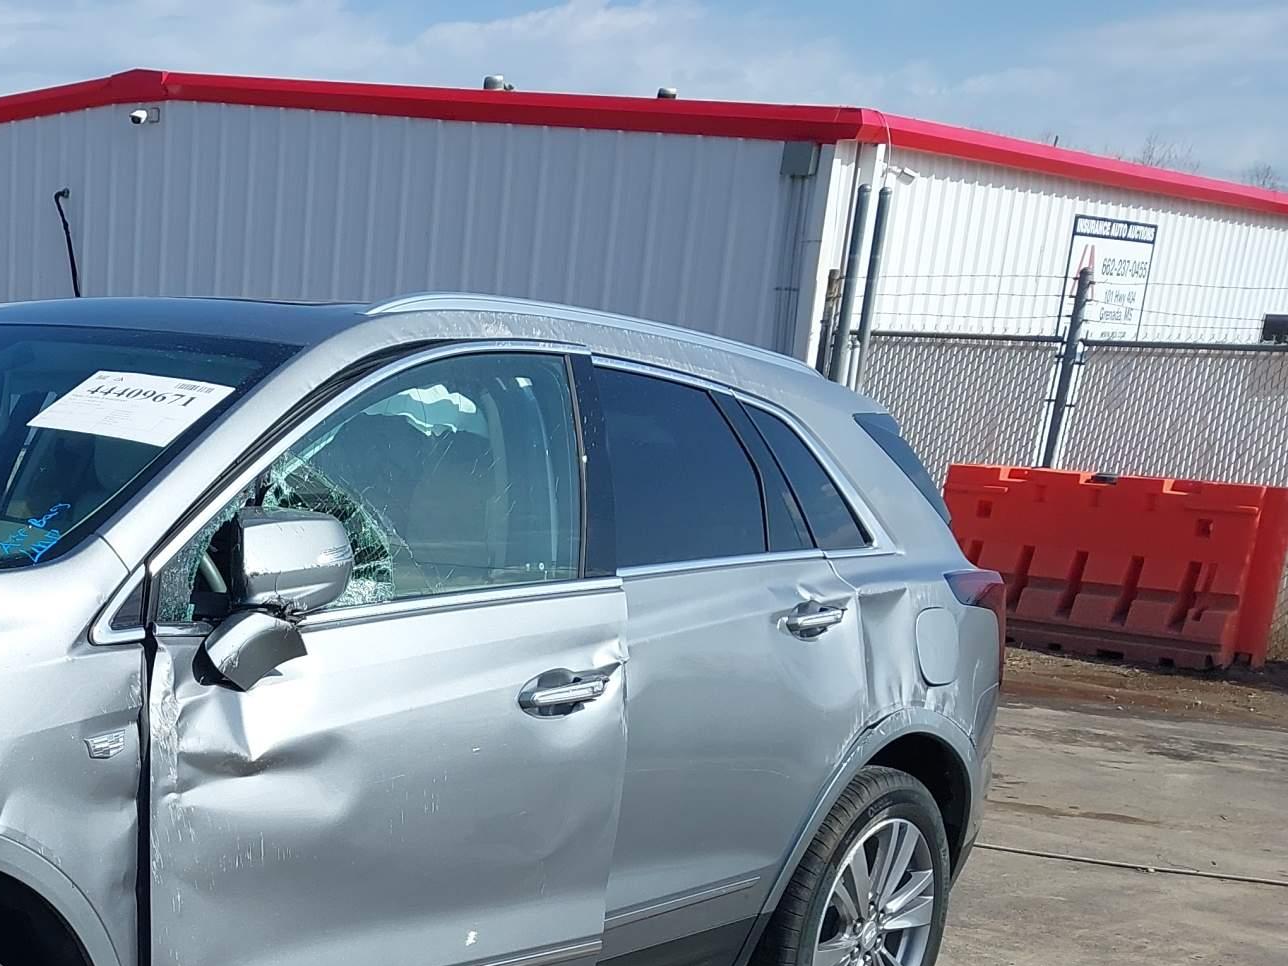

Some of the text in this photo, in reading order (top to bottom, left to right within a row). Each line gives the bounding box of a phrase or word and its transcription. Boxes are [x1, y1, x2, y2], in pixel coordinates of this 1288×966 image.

[1076, 218, 1155, 241] INSURANCE AUTO AUCTIONS
[87, 384, 196, 407] 44409671
